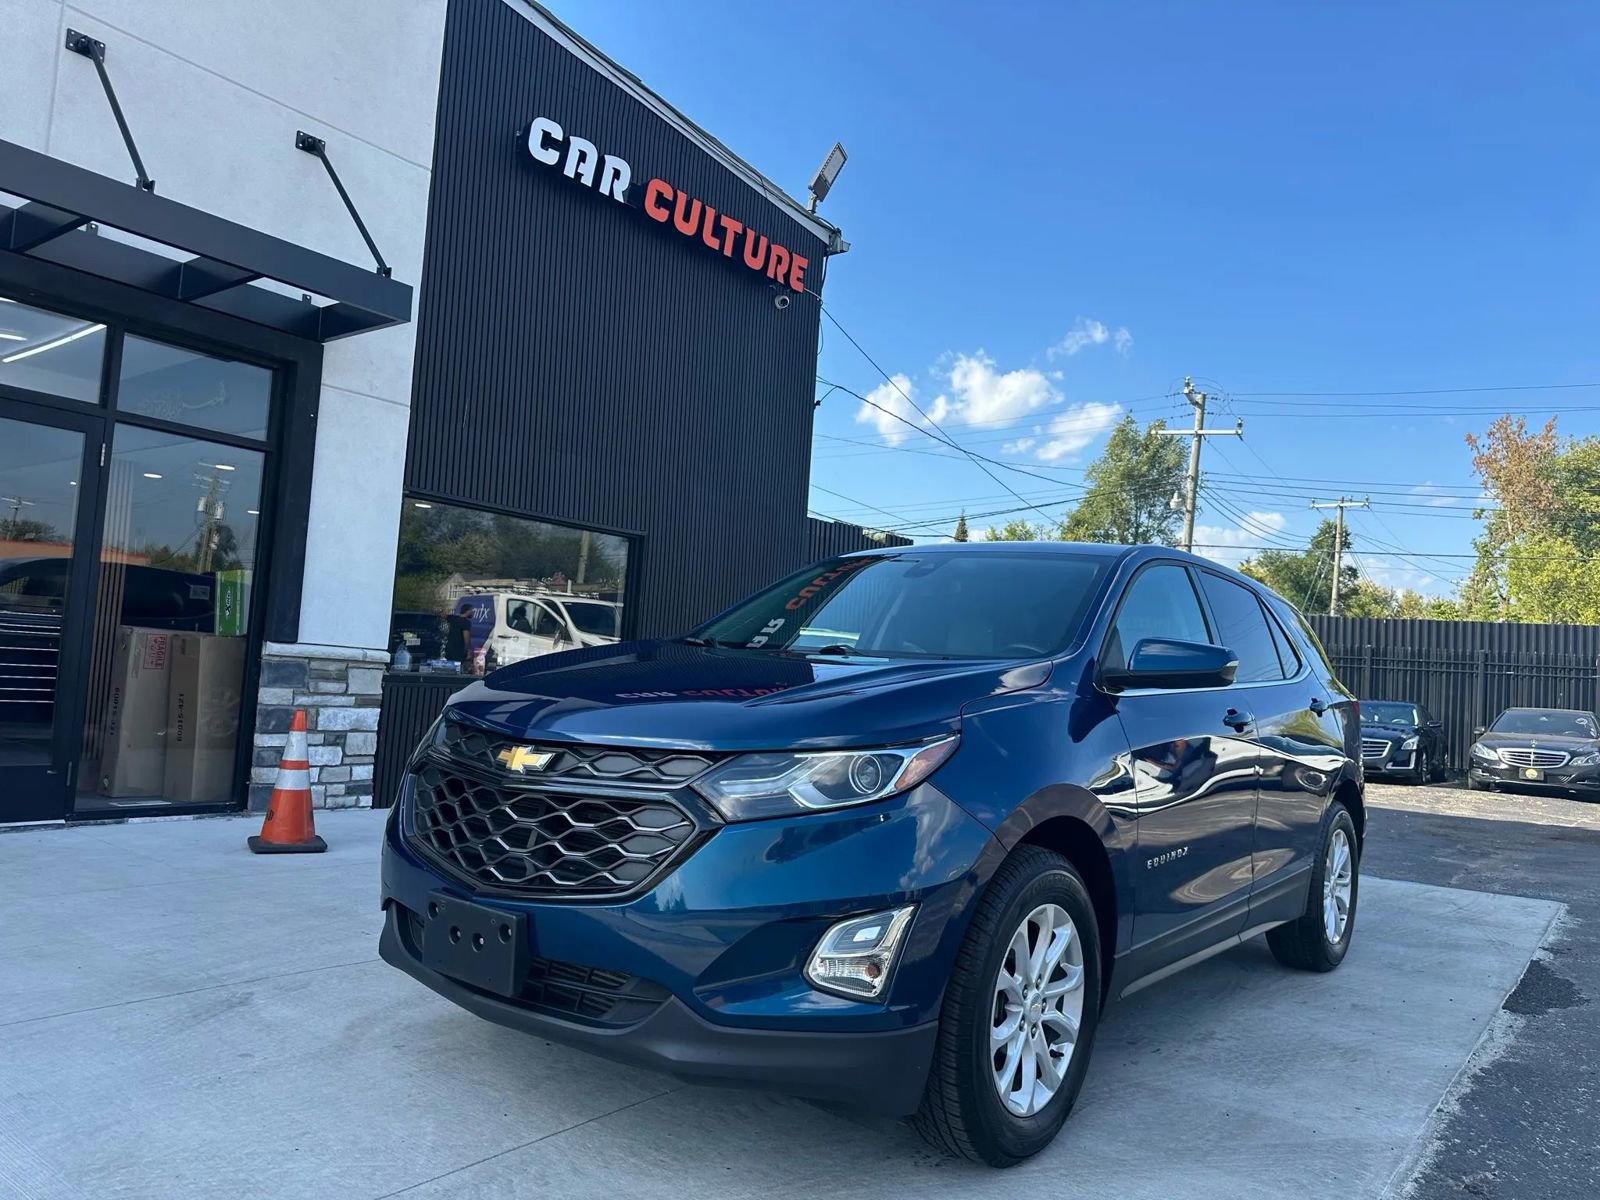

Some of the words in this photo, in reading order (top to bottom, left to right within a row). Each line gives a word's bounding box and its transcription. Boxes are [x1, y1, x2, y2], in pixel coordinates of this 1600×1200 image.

[528, 116, 632, 204] CAR
[644, 178, 809, 293] CULTURE
[1147, 846, 1189, 869] EQUINOX
